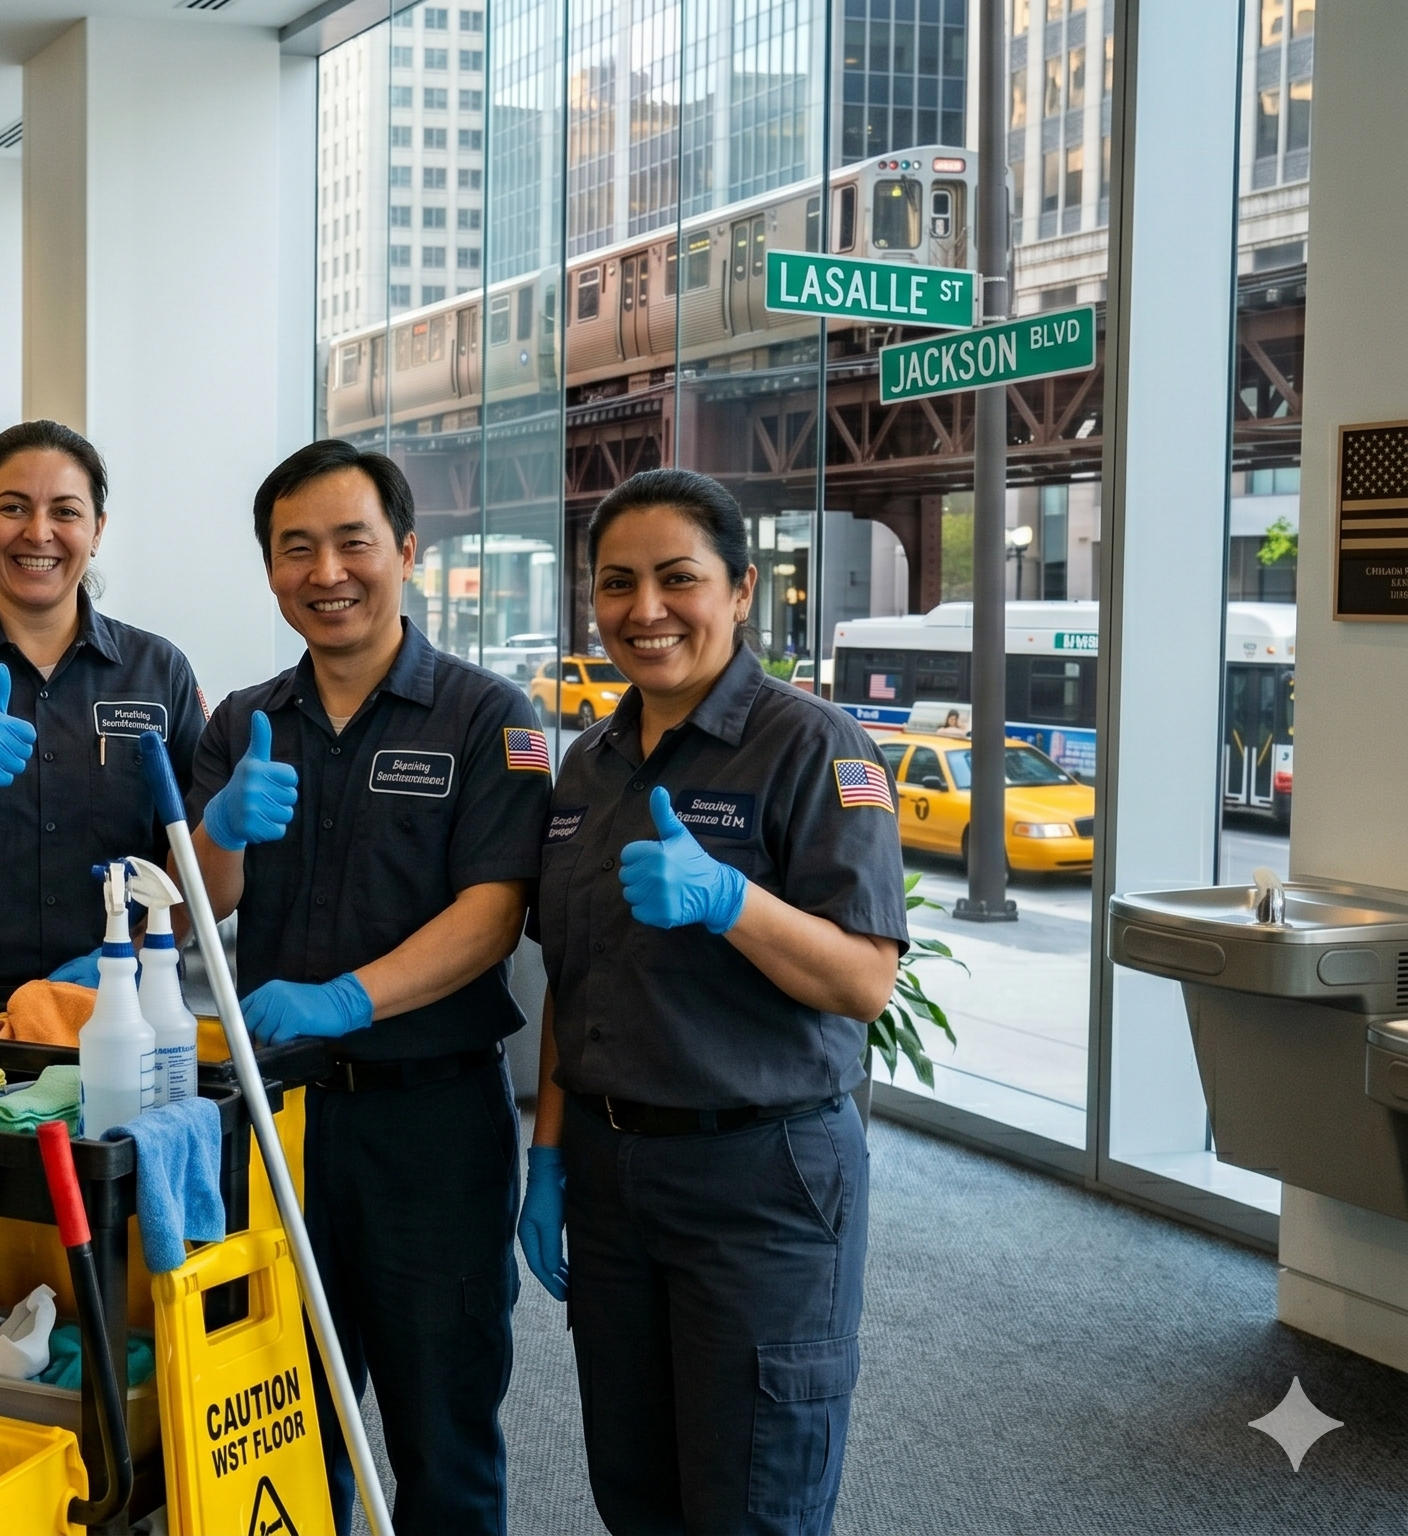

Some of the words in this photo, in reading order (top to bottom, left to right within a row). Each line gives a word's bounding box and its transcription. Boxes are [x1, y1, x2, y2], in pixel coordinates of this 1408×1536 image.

[780, 262, 928, 315] LASALLE
[939, 280, 964, 302] ST
[891, 331, 1017, 393] JACKSON
[1029, 319, 1081, 350] BLVD
[206, 1366, 301, 1441] CAUTION
[211, 1436, 248, 1479] WST
[253, 1410, 306, 1460] FLOOR
